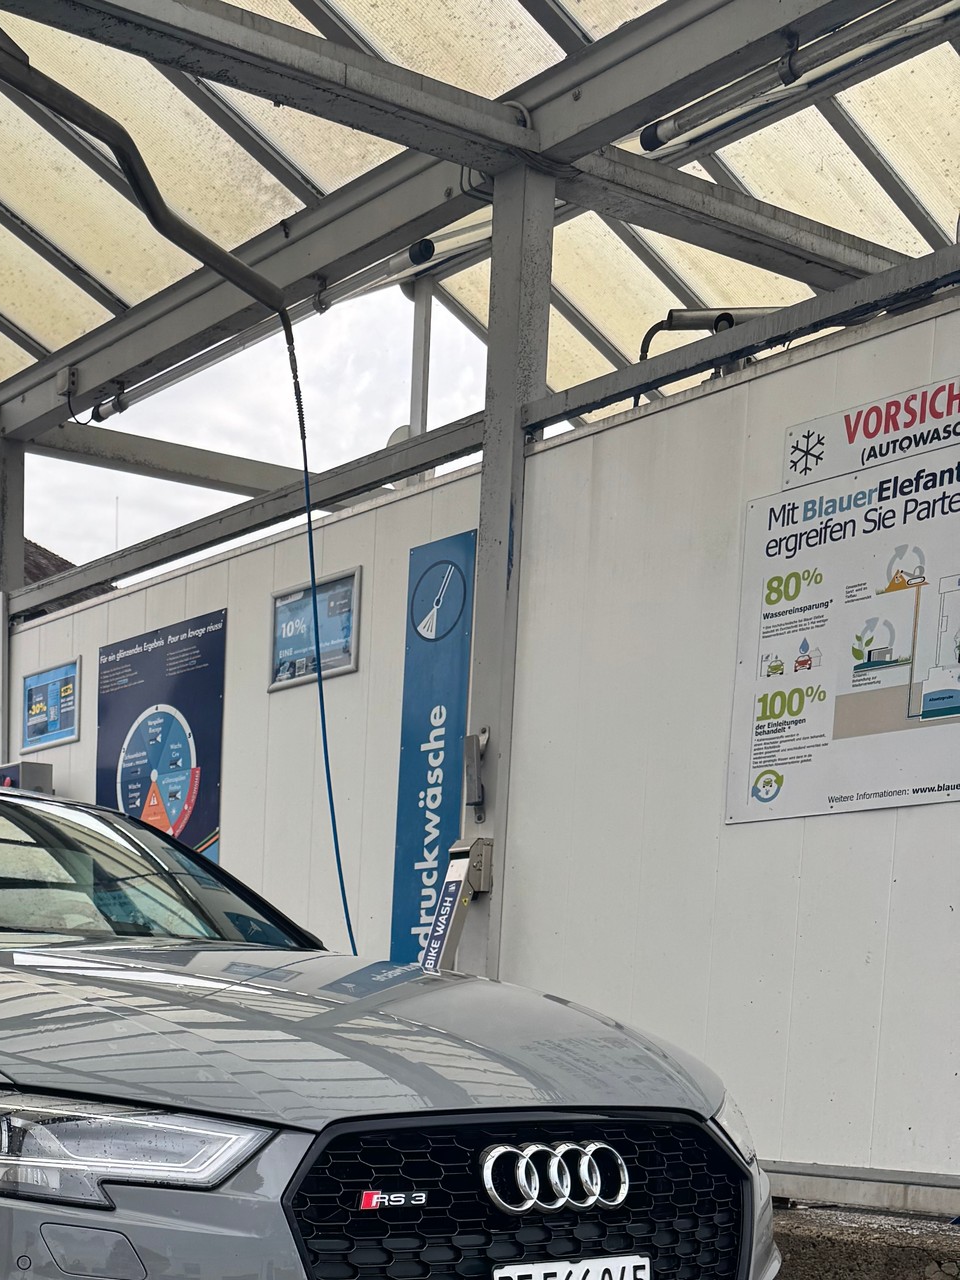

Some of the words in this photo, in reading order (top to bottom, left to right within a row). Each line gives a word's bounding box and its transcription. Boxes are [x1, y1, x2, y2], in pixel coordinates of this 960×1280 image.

[844, 382, 960, 444] VORSICH
[765, 518, 856, 559] ergreifen
[862, 507, 896, 534] Sie
[903, 491, 960, 525] Parte
[768, 502, 798, 531] Mit
[764, 568, 823, 606] 80%
[281, 617, 306, 638] 10%
[756, 684, 827, 722] 100%
[767, 718, 806, 729] Einleitungen
[828, 795, 854, 803] Weitere
[856, 788, 910, 801] Informationen:
[411, 704, 447, 962] druckwäsche
[424, 940, 441, 969] BIKE
[434, 897, 454, 936] WASH
[371, 1194, 406, 1206] RS
[411, 1193, 426, 1204] 3
